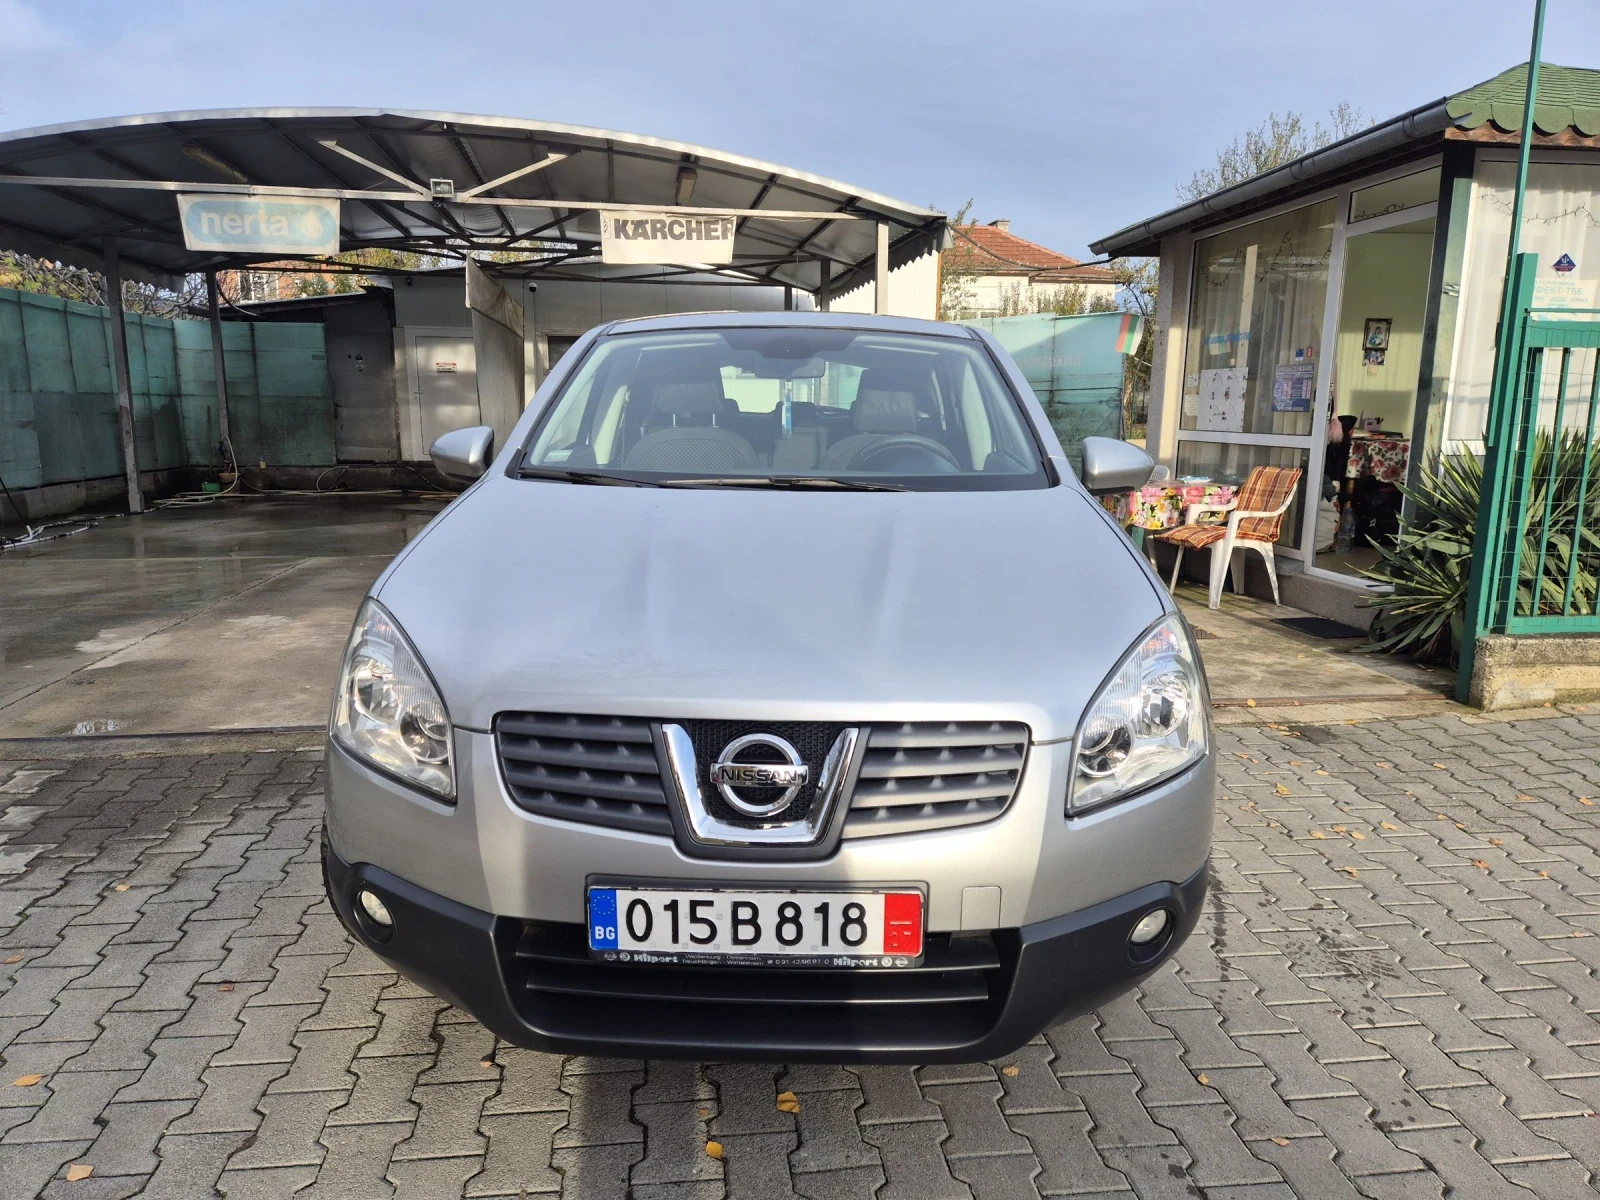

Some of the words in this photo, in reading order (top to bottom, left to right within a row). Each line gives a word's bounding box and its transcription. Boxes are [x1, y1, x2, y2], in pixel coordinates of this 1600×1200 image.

[201, 207, 289, 237] nerta
[721, 768, 799, 782] NISSAN
[595, 926, 616, 940] BG
[625, 898, 868, 947] 015B818
